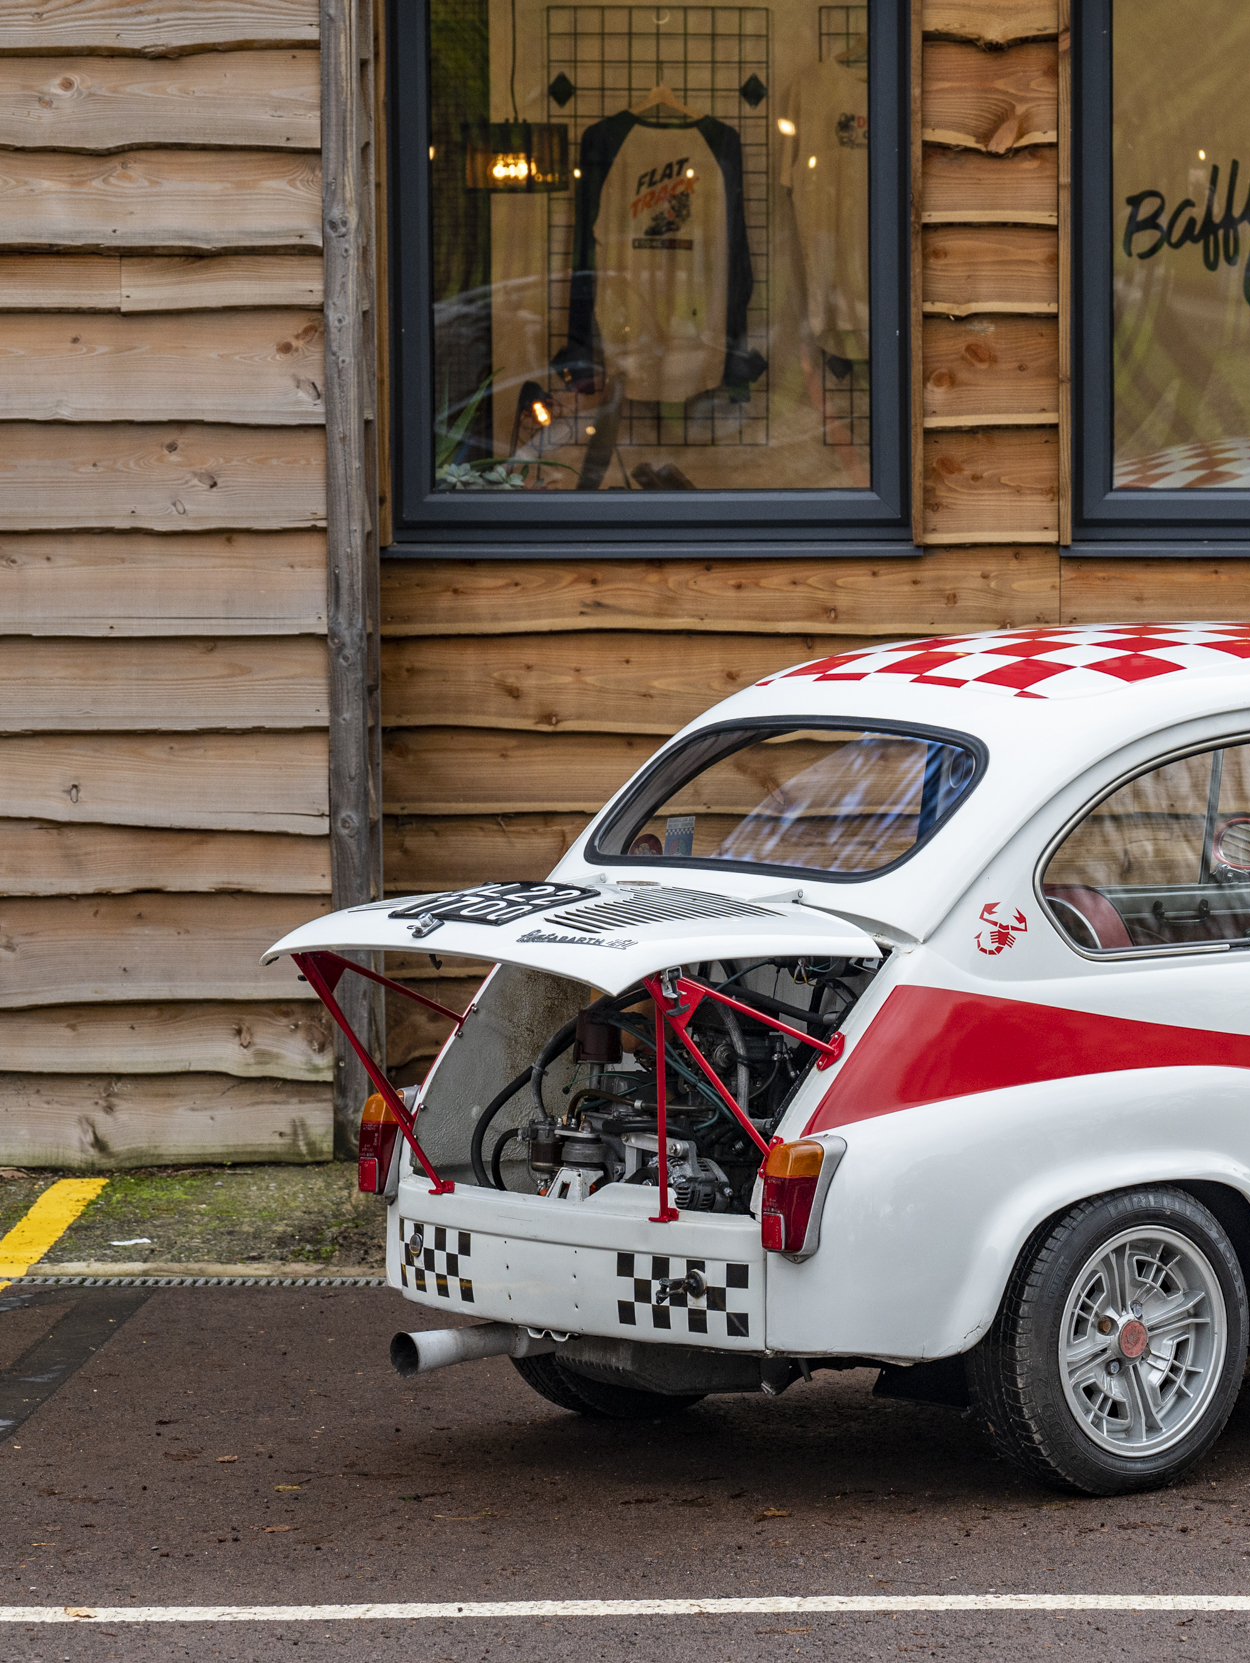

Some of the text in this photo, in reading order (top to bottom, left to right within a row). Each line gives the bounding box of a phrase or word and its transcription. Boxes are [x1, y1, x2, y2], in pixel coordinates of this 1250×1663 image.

[635, 157, 690, 195] FLAT
[631, 176, 699, 219] TRACK
[403, 896, 533, 920] 1700
[547, 934, 605, 946] ABARTH
[1106, 1191, 1192, 1218] PIRELLI
